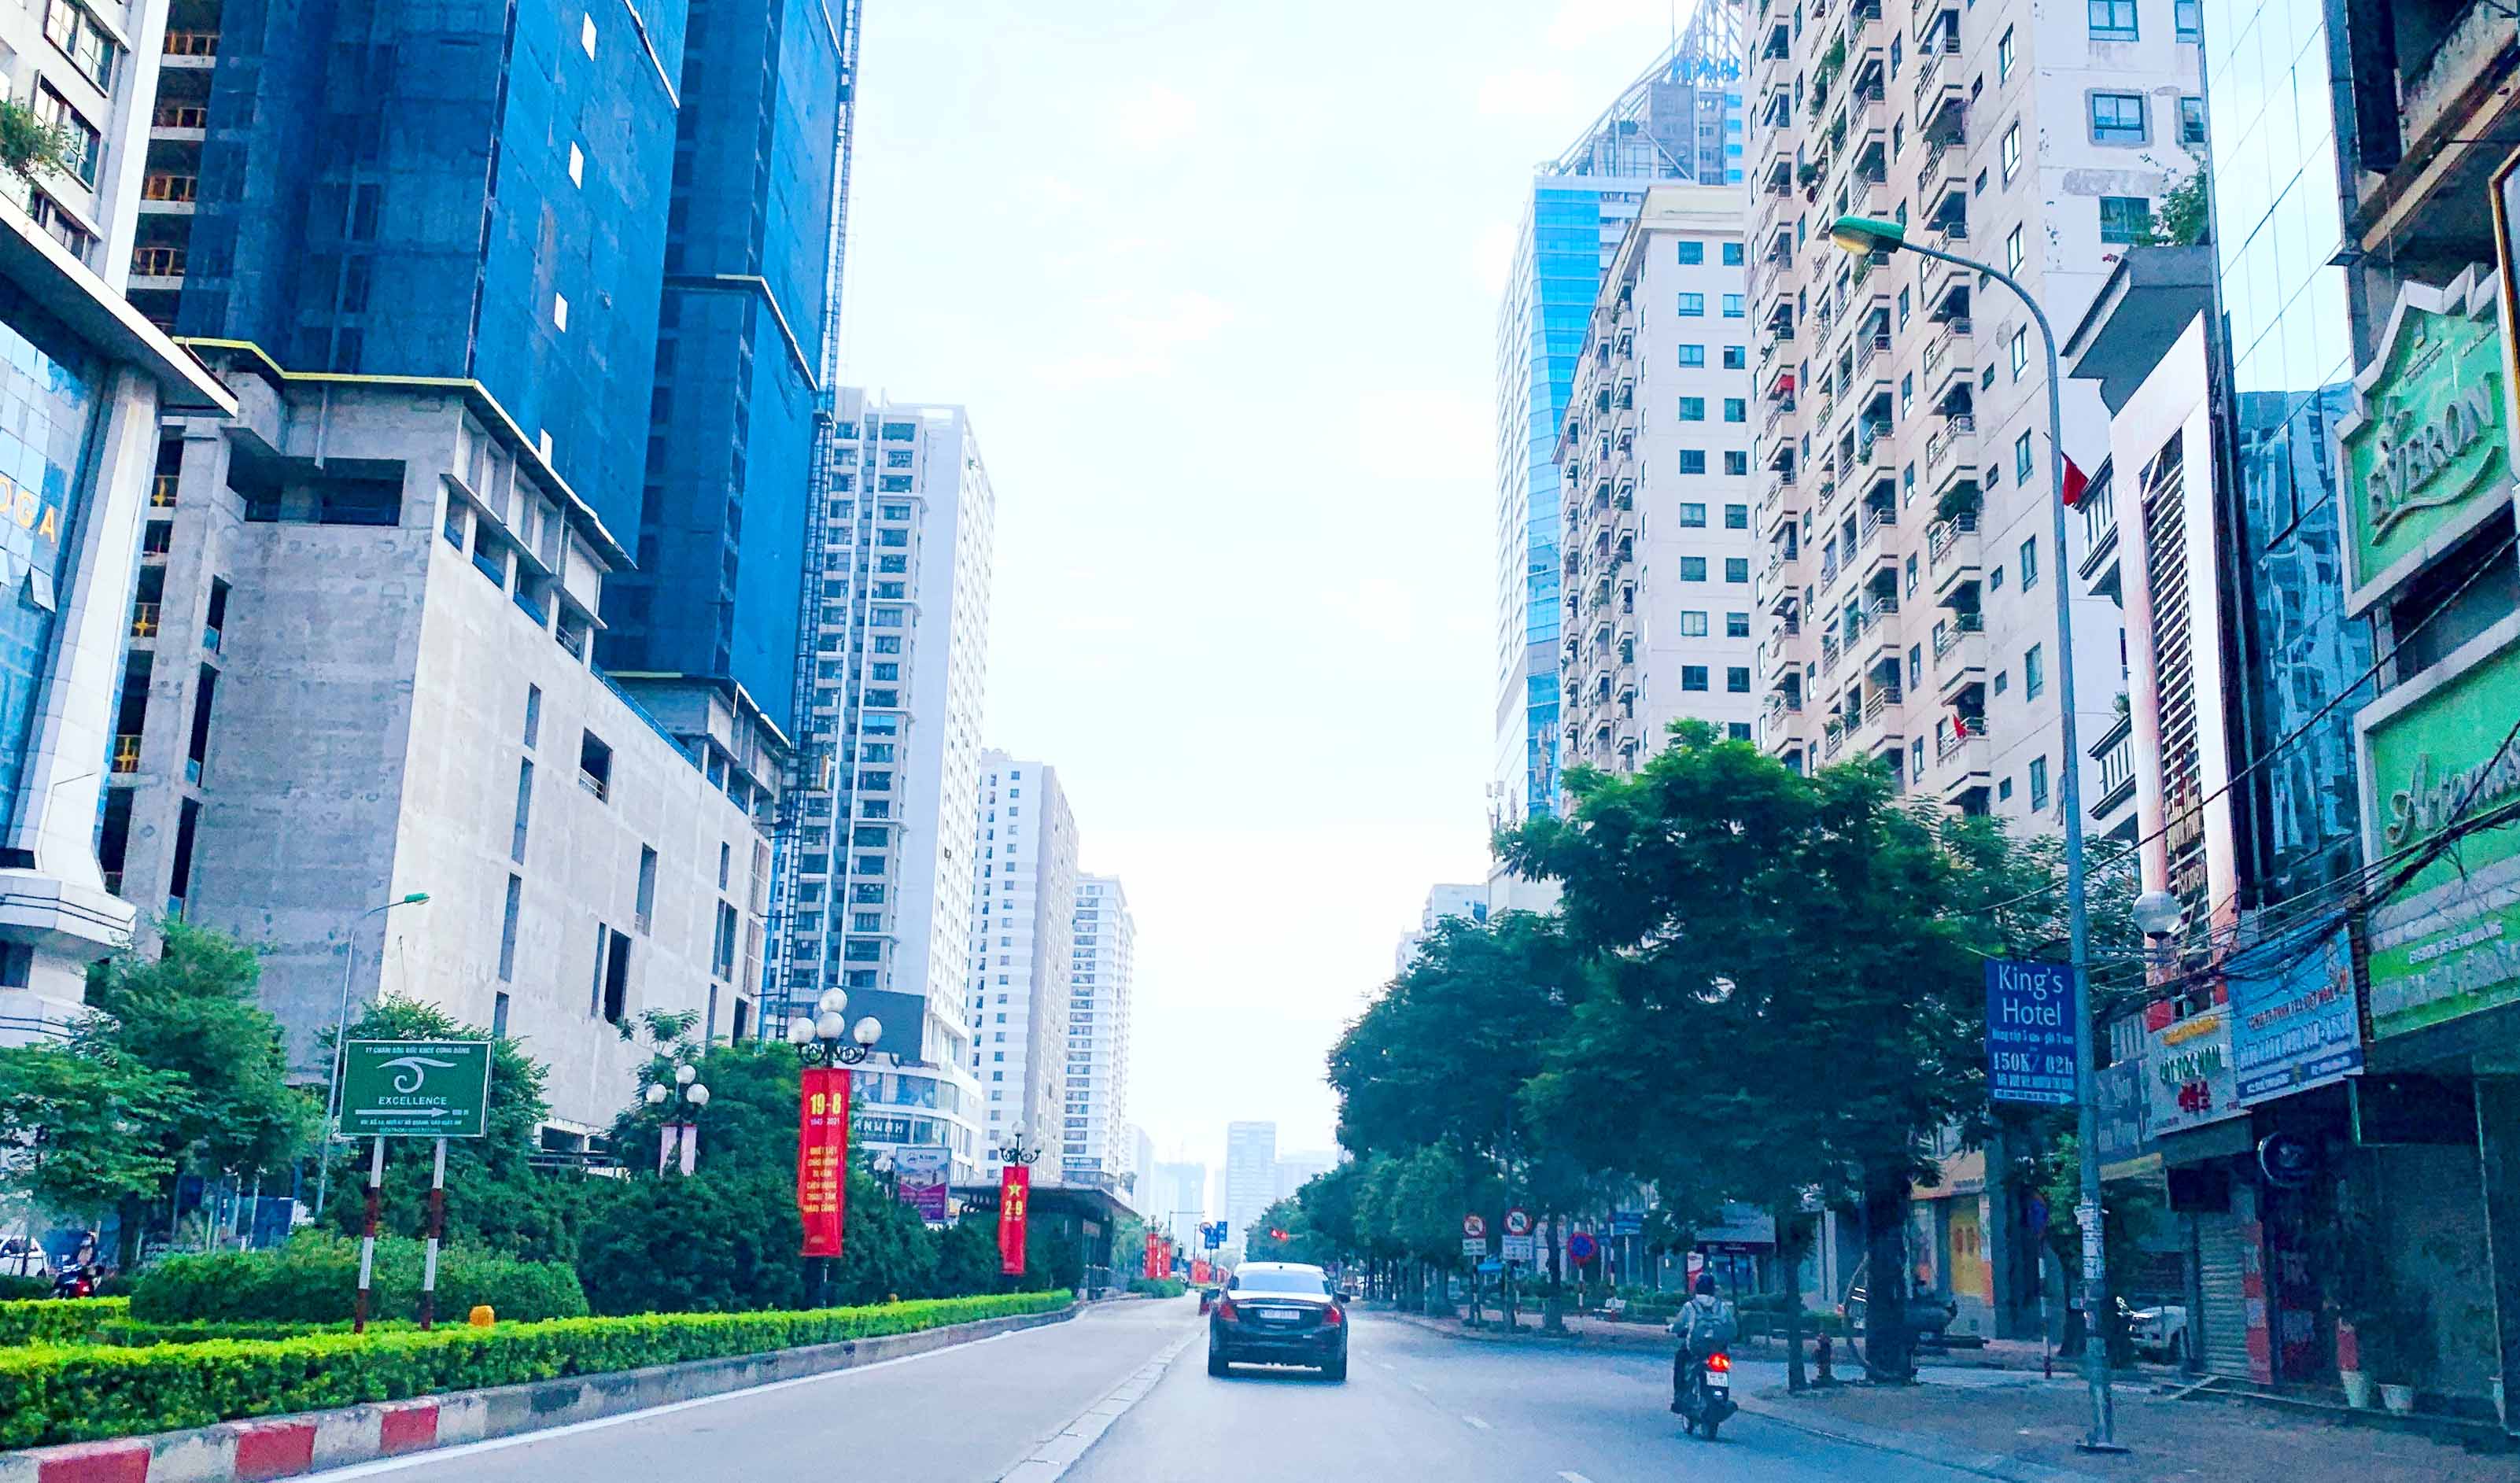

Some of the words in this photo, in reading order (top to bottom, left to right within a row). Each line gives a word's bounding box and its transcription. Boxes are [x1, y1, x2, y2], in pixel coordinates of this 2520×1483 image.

[1998, 965, 2064, 1000] King's
[2002, 998, 2061, 1026] Hotel
[378, 1096, 448, 1105] EXCELLENCE
